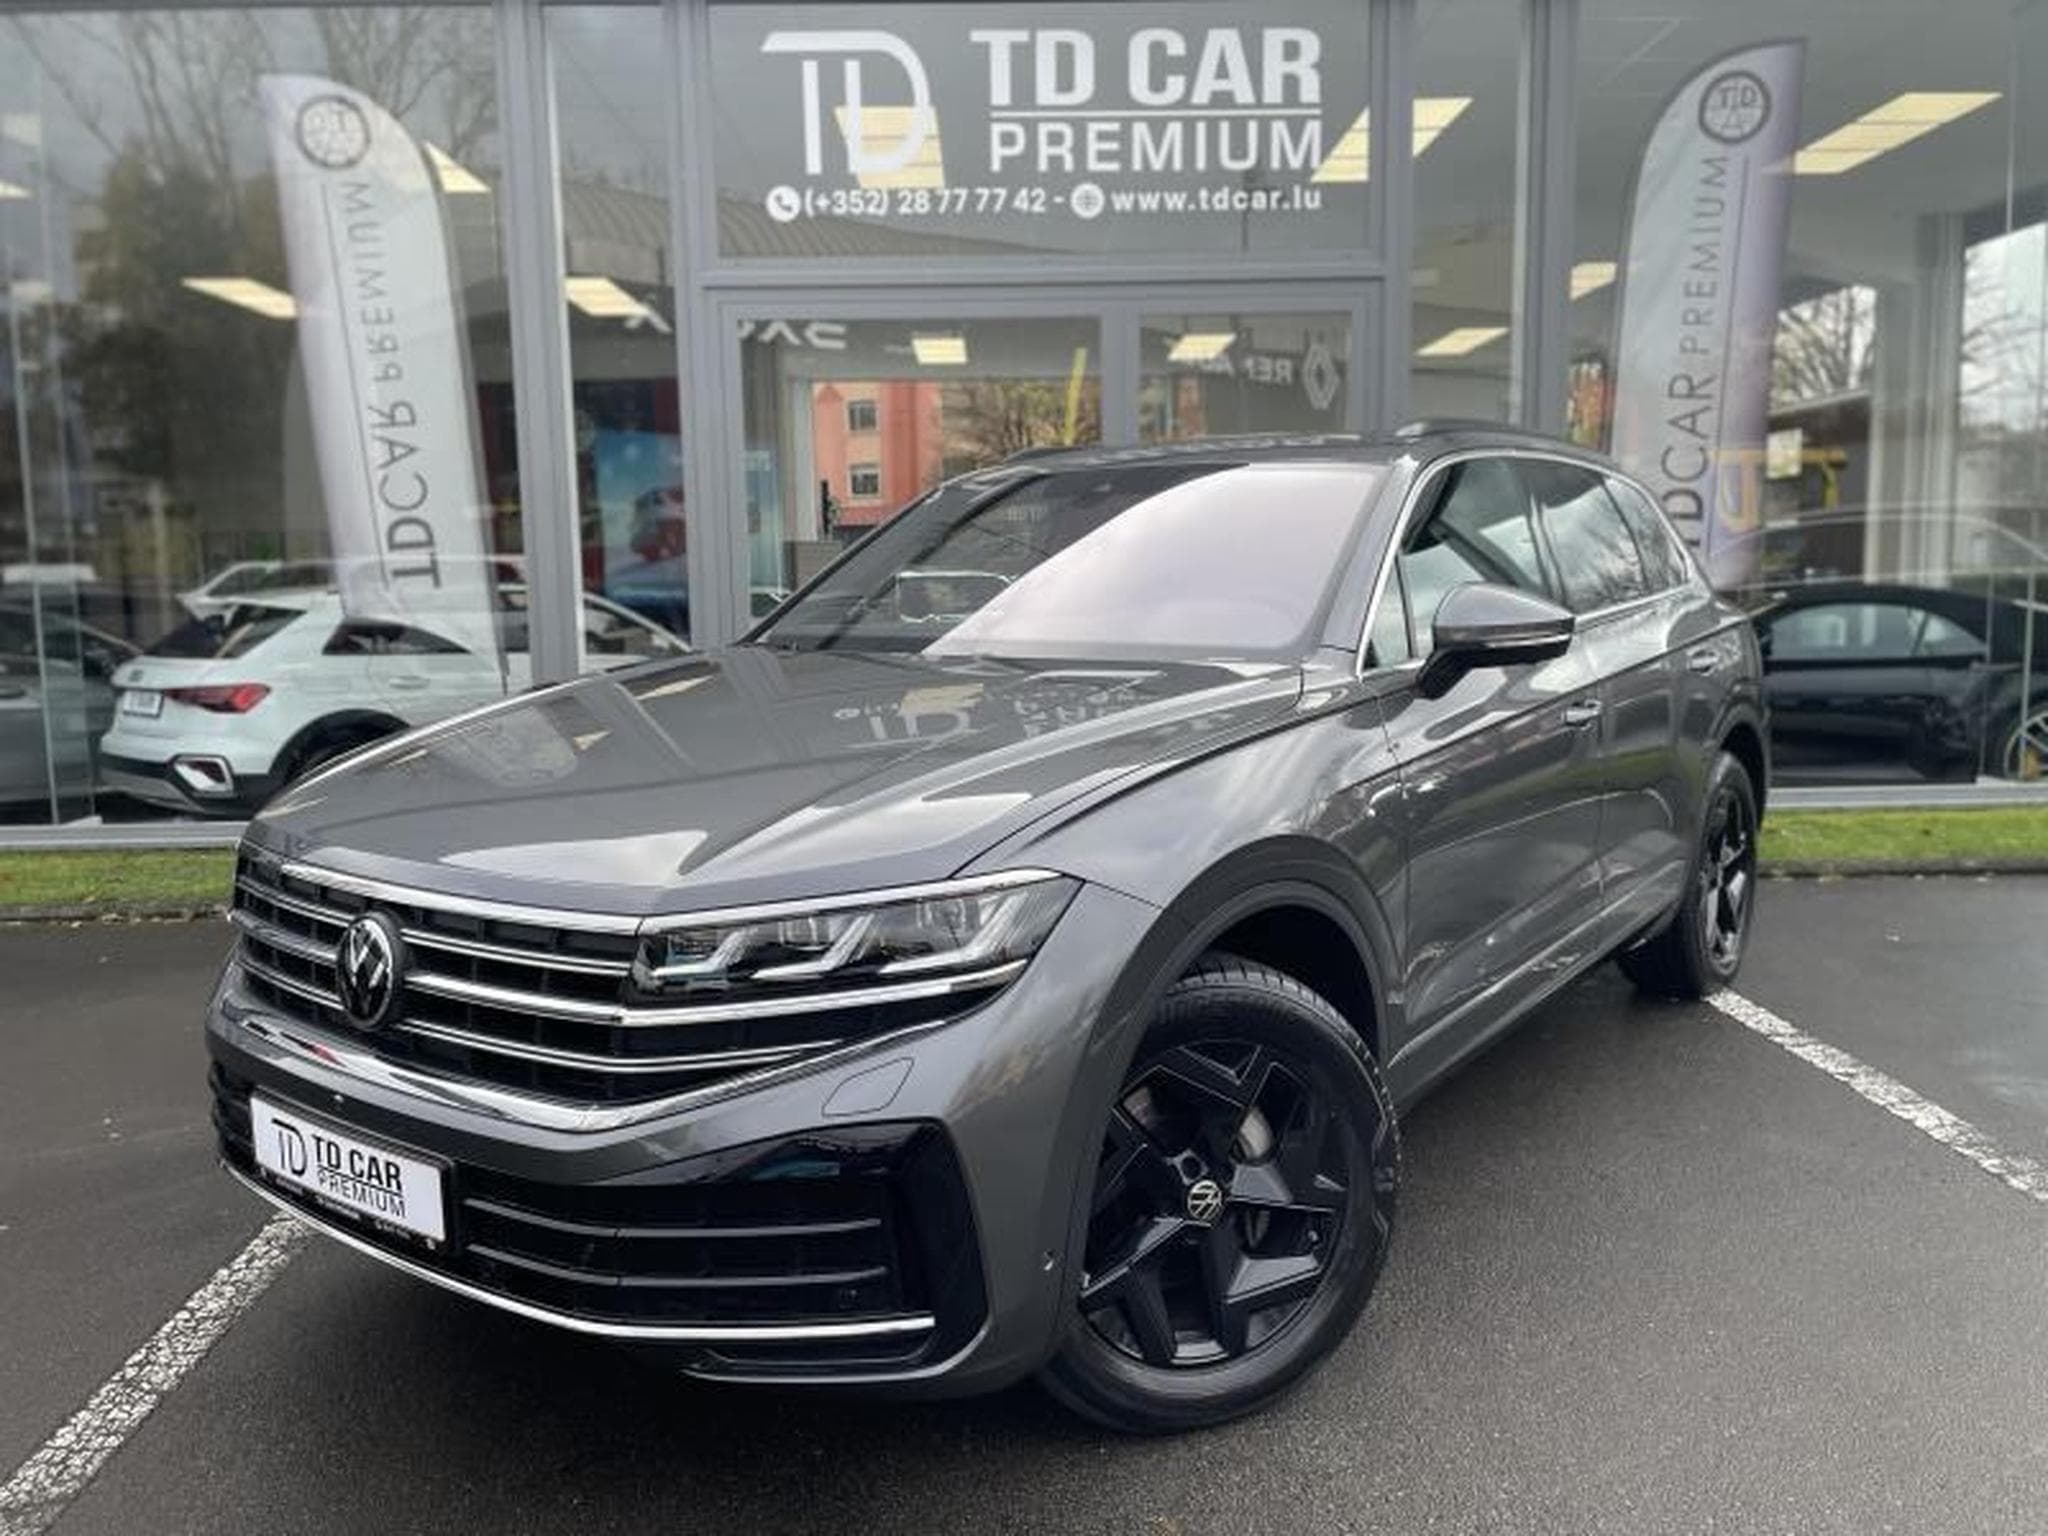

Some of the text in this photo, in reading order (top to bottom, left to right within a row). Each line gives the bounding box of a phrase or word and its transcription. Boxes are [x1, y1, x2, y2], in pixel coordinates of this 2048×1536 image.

[970, 28, 1322, 107] TD CAR
[989, 119, 1324, 173] PREMIUM
[803, 187, 890, 218] (+352)
[897, 188, 932, 214] 28
[934, 187, 966, 213] 77
[972, 187, 1006, 213] 77
[1012, 186, 1047, 213] 42
[1109, 184, 1323, 214] www.tdcar.lu
[1679, 155, 1730, 358] PREMIUM
[311, 1134, 402, 1192] TD CAR
[316, 1165, 407, 1220] PREMIUM
